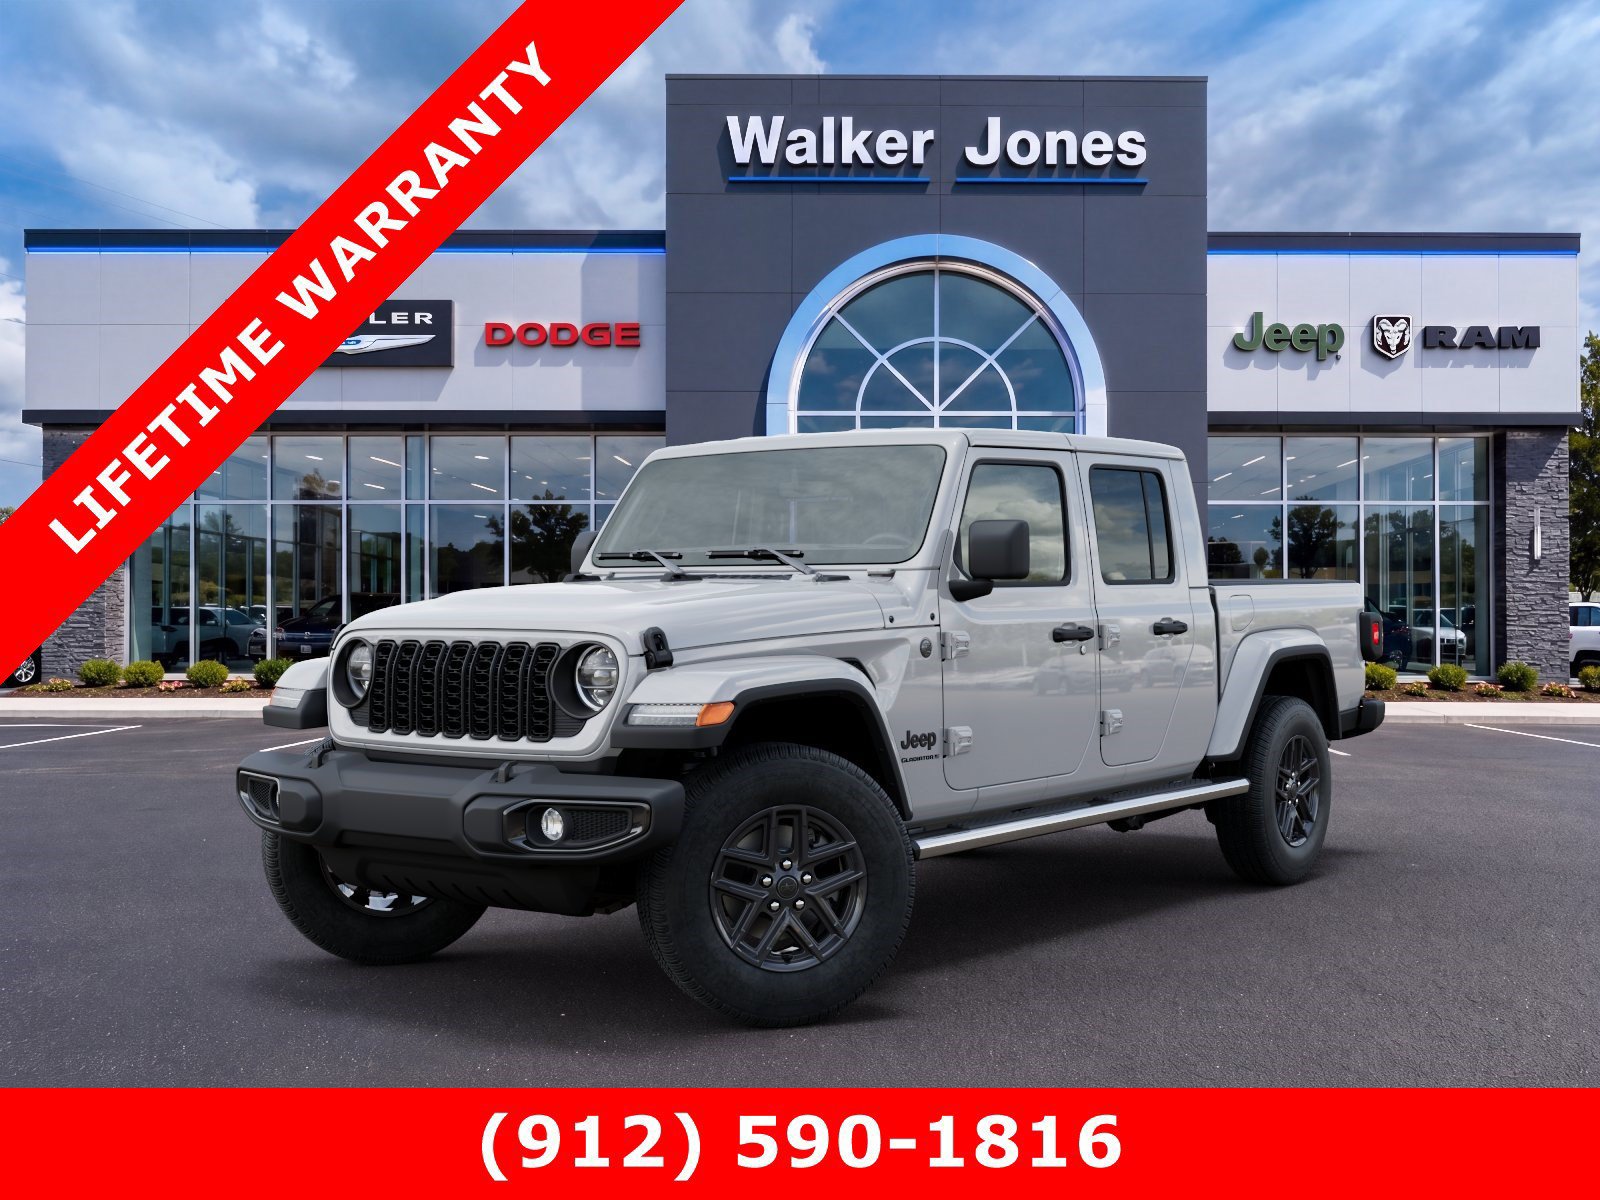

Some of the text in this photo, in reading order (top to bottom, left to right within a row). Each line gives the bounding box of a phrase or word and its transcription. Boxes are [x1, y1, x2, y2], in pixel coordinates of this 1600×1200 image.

[726, 115, 1148, 167] Walker Jones
[484, 322, 642, 347] DODGE
[1234, 311, 1345, 361] Jeep
[1422, 325, 1541, 349] RAM
[900, 730, 937, 750] Jeep
